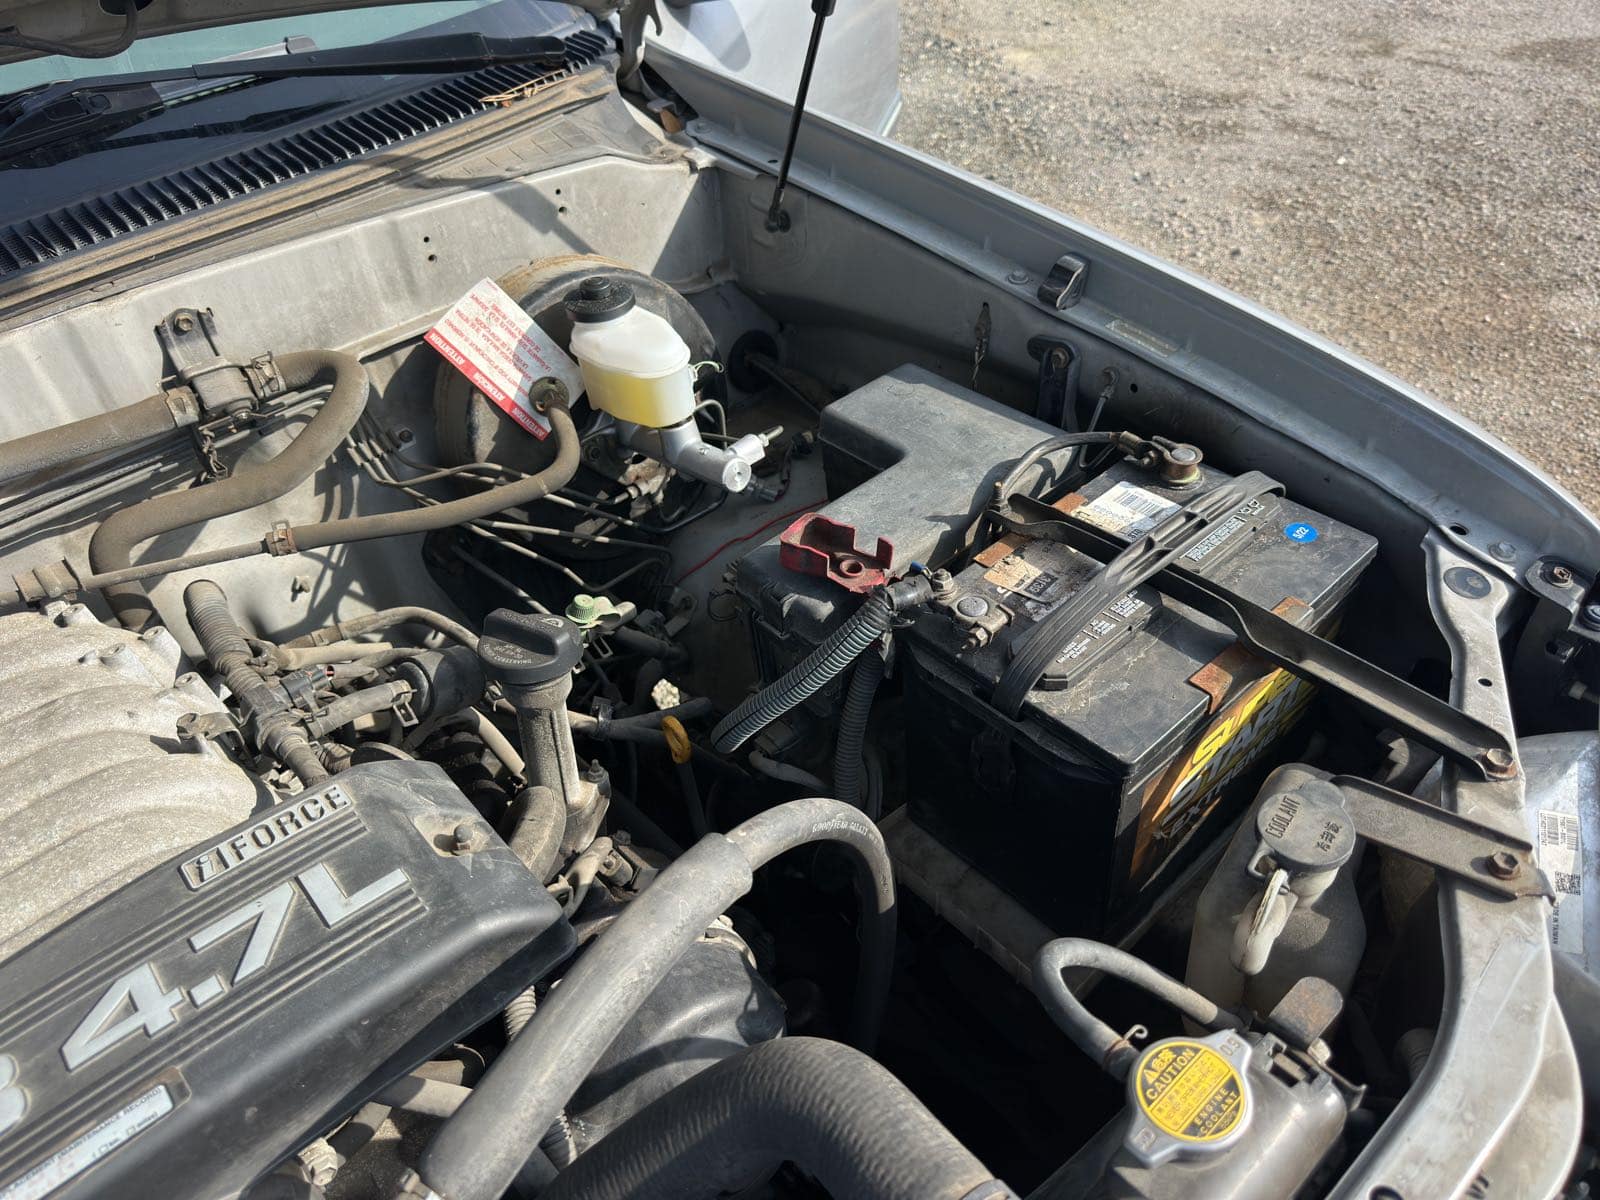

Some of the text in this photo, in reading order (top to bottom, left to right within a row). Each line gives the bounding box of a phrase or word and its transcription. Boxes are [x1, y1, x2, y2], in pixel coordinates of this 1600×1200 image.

[429, 332, 466, 366] ATTENTION
[511, 407, 545, 437] ATTENTION
[1265, 795, 1301, 838] COOLANT
[1551, 924, 1559, 945] TAIWAN
[60, 862, 409, 1073] 4.7L
[1146, 1047, 1196, 1100] CAUTION
[1193, 1086, 1230, 1125] ENGINE
[1199, 1092, 1239, 1135] COOLANT
